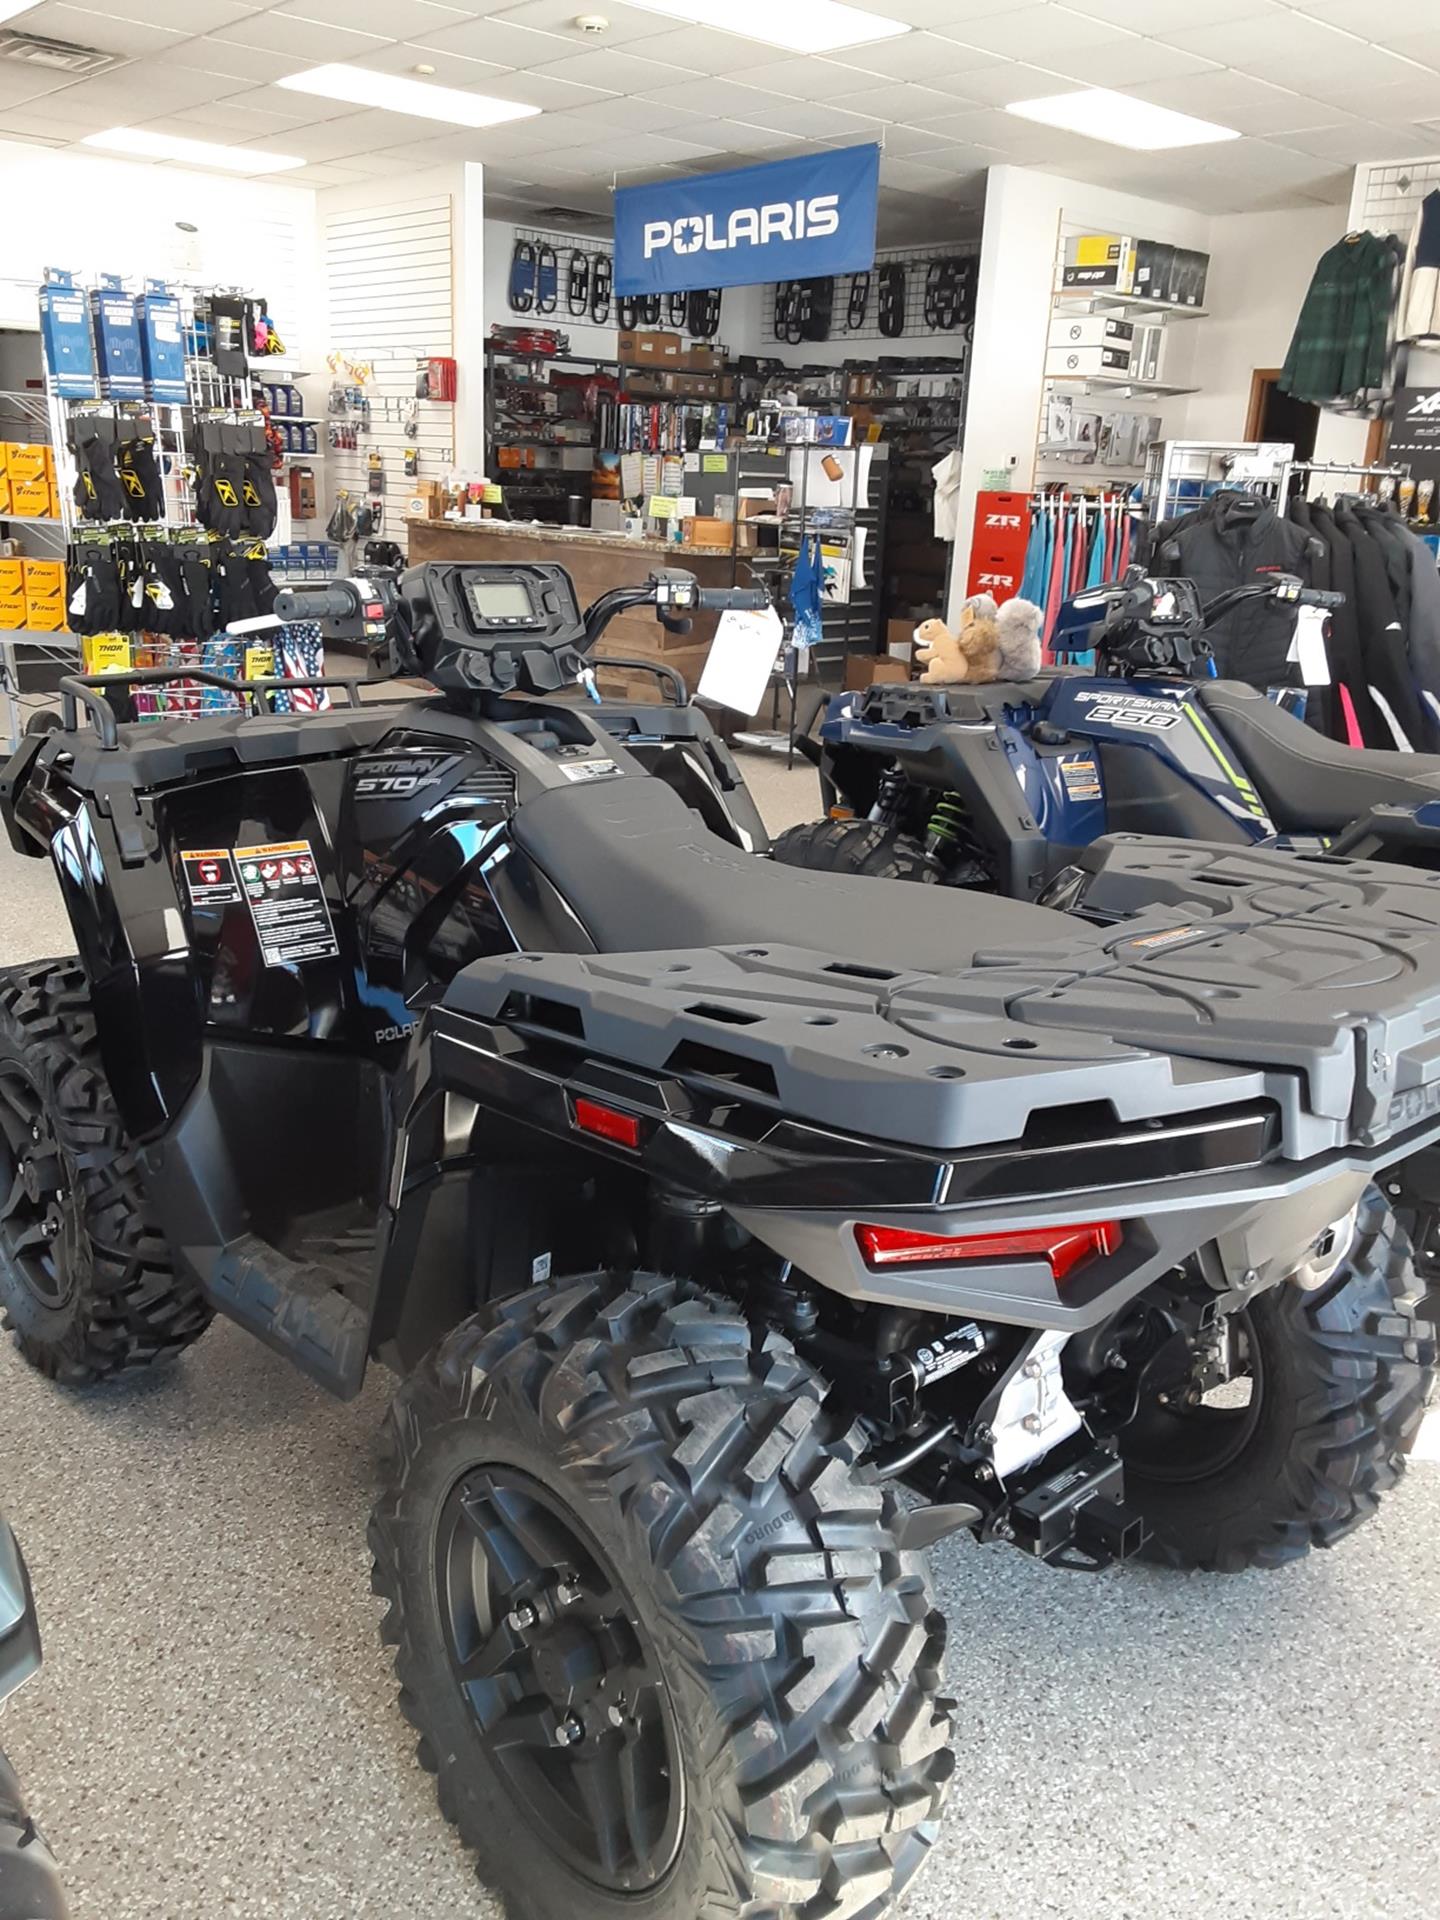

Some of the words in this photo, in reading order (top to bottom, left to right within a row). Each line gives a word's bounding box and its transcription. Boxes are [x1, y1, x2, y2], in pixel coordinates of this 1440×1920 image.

[644, 195, 839, 259] POLARIS
[985, 514, 1021, 527] ZR
[977, 573, 1014, 587] ZR
[1074, 691, 1184, 713] SPORTSMAN
[1085, 705, 1183, 730] 850
[355, 777, 419, 791] 570
